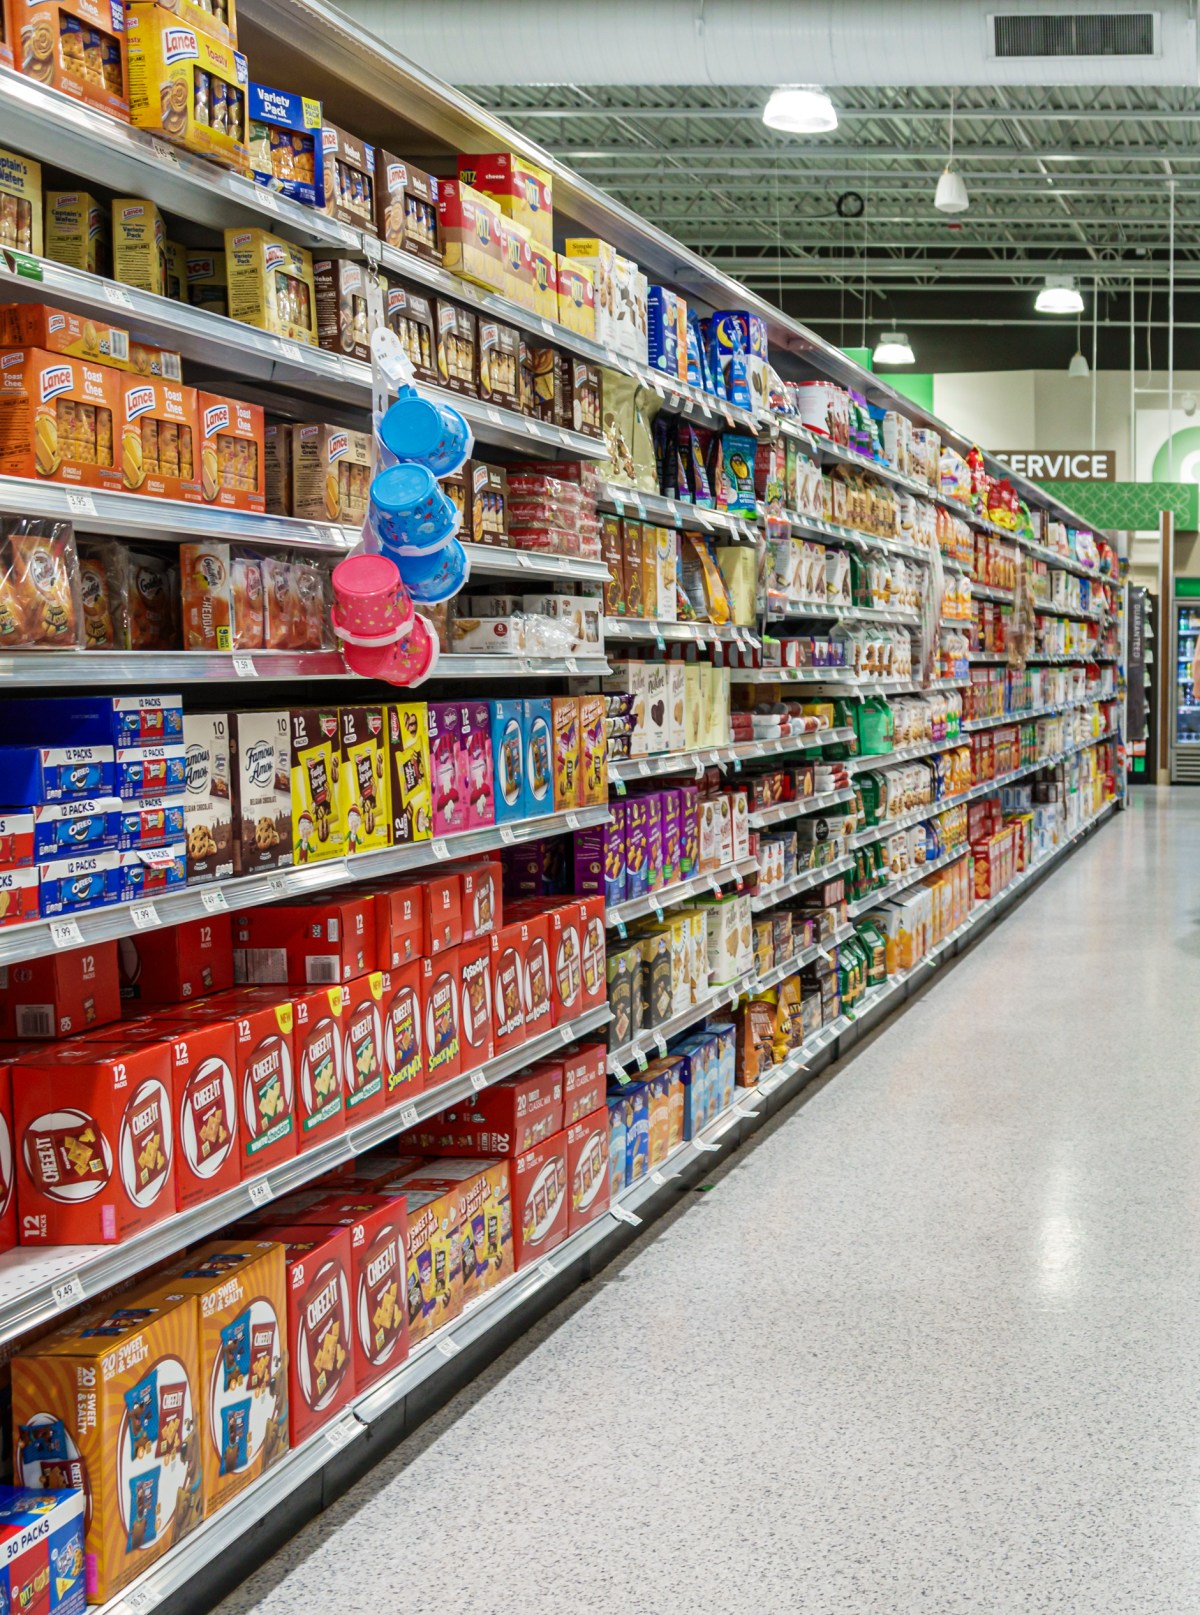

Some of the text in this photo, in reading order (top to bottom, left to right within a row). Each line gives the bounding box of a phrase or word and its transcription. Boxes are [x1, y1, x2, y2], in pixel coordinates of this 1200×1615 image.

[166, 35, 195, 52] Lance
[206, 45, 227, 66] Toasty
[258, 88, 289, 108] Variety
[264, 101, 287, 117] Pack
[0, 157, 27, 175] ptain's
[389, 170, 405, 185] Lance
[460, 170, 477, 183] RITZ
[123, 208, 143, 218] Lance
[573, 243, 593, 251] Simple
[2, 354, 23, 367] Lance
[4, 372, 23, 380] Toast
[43, 370, 71, 393] Lance
[83, 367, 102, 383] Toast
[85, 382, 103, 397] Chee
[163, 387, 182, 401] Toast
[128, 390, 153, 411] Lance
[166, 400, 183, 414] Chee
[206, 409, 228, 427] Lance
[236, 405, 251, 419] Toast
[237, 418, 251, 431] Chee
[330, 436, 347, 455] Lance
[70, 495, 86, 507] 3.95
[202, 596, 214, 638] CHEDDAR
[139, 698, 161, 707] 12 PACKS
[343, 715, 355, 733] 12
[429, 710, 436, 728] 12
[461, 708, 469, 725] 12
[213, 721, 224, 734] 10
[277, 718, 286, 731] 10
[294, 716, 306, 737] 12
[66, 748, 92, 759] 12 PACKS
[143, 748, 164, 757] 12 PACKS
[246, 740, 274, 770] Famous
[70, 767, 89, 782] OREO
[250, 763, 272, 786] Amos
[61, 801, 95, 816] 12 PACKS
[146, 799, 162, 807] PACKS
[250, 797, 262, 805] BELGIAN
[69, 819, 92, 834] OREO
[153, 850, 169, 858] PACKS
[68, 859, 96, 873] 12 PACKS
[72, 877, 92, 892] OREO
[135, 910, 149, 919] 7.99
[55, 927, 70, 937] 7.99
[201, 927, 211, 941] 12
[82, 956, 94, 972] 12
[298, 1003, 308, 1017] 12
[280, 1012, 291, 1024] NEW
[239, 1020, 250, 1035] 12
[175, 1043, 187, 1059] 12
[113, 1064, 126, 1082] 12
[268, 1119, 290, 1144] cheddar
[252, 1185, 264, 1197] 9.49
[24, 1215, 39, 1237] 12
[353, 1225, 364, 1242] 20
[292, 1265, 304, 1280] 20
[57, 1284, 73, 1299] 9.49
[218, 1278, 238, 1298] SWEET
[223, 1287, 243, 1308] SALTY
[118, 1335, 142, 1360] SWEET
[127, 1347, 148, 1369] SALTY
[88, 1394, 96, 1427] SWEET
[77, 1403, 86, 1434] SALTY
[7, 1520, 49, 1557] 30 PACKS
[20, 1582, 35, 1607] RITZ
[131, 1592, 146, 1607] 10.79
